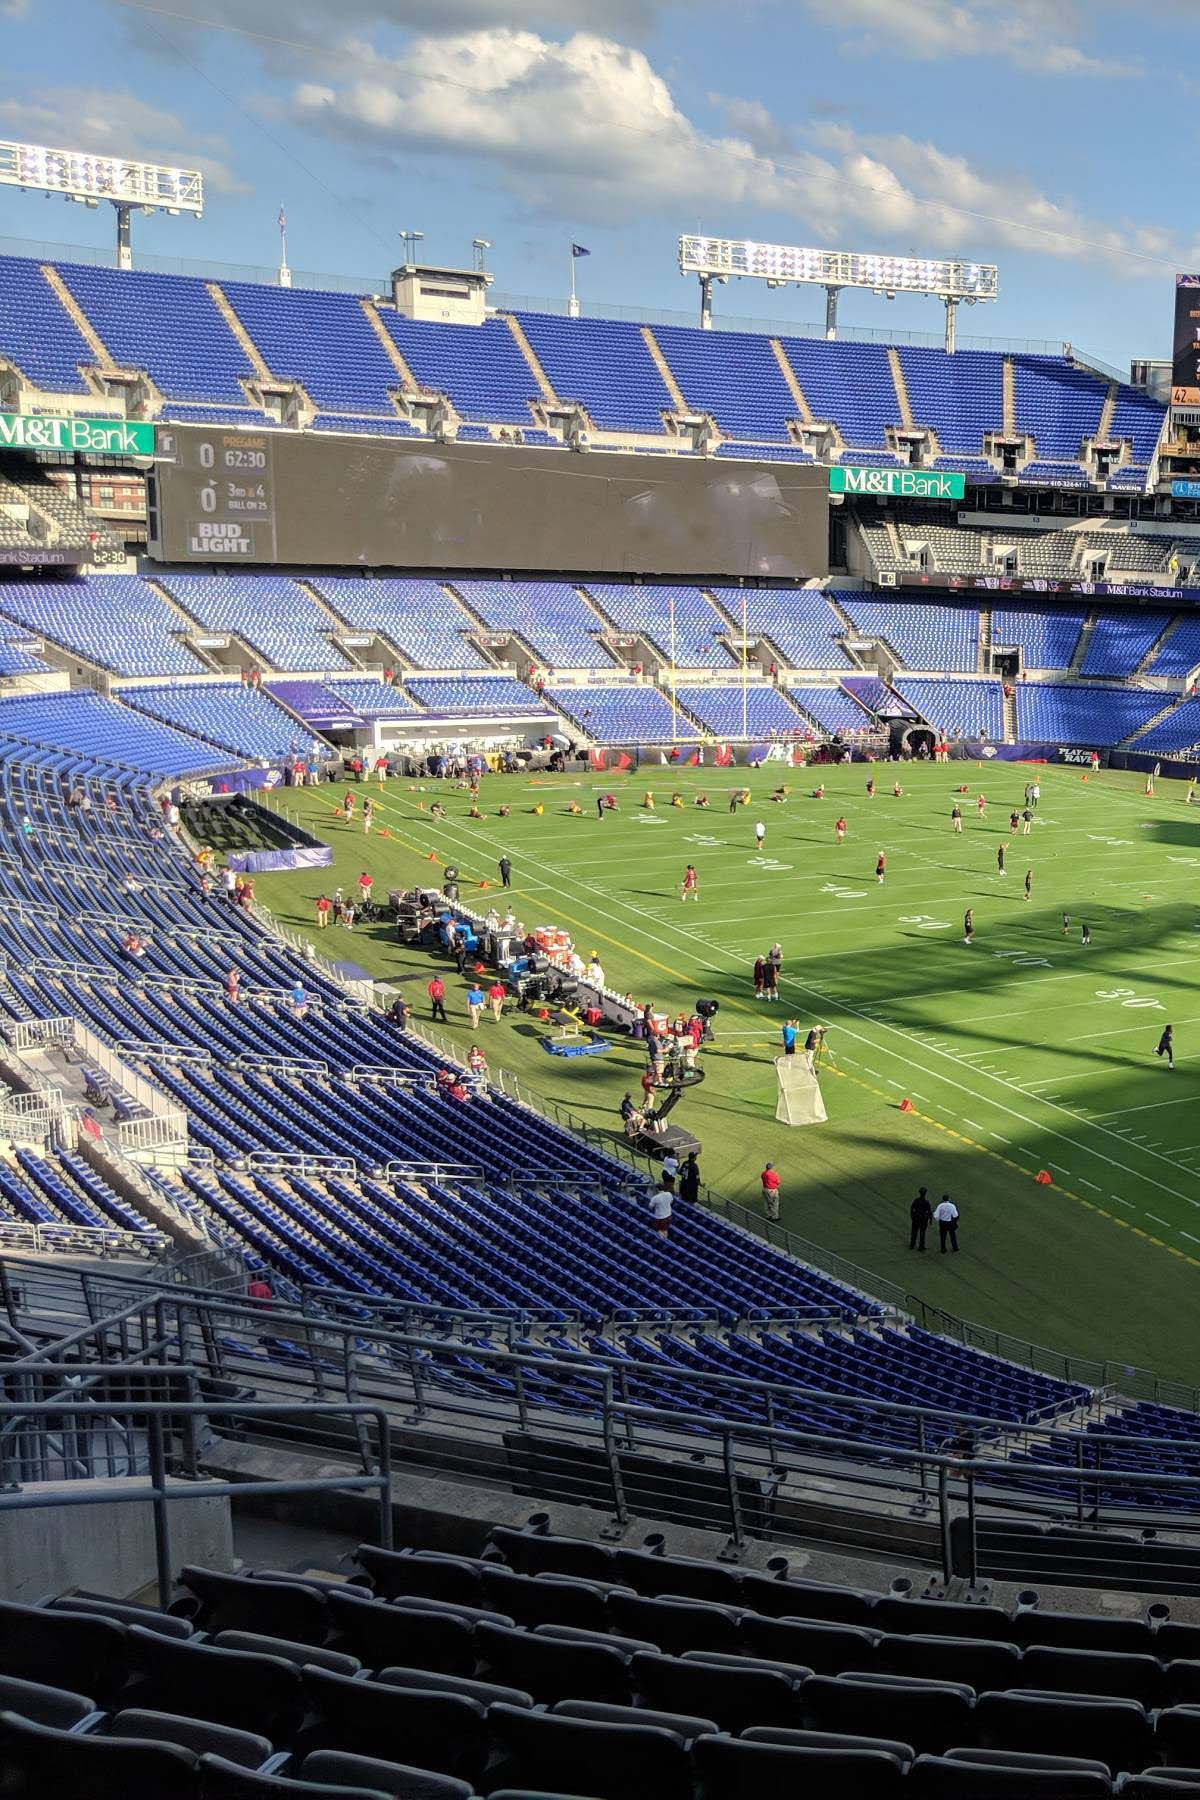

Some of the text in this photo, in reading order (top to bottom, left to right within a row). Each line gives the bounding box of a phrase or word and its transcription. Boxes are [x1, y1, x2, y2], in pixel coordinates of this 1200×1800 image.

[1174, 389, 1186, 403] 42
[0, 416, 139, 450] M&T Bank
[200, 443, 214, 468] 0
[225, 451, 267, 468] 62:30
[256, 484, 264, 497] 4
[843, 469, 952, 497] M&T Bank
[201, 488, 216, 512] 0
[199, 523, 242, 538] BUD
[191, 537, 250, 553] LIGHT
[19, 551, 64, 564] Stadium
[93, 551, 126, 563] 62:30
[1107, 585, 1183, 598] M&T Bank Stadium
[898, 914, 952, 929] 50
[1095, 988, 1159, 1009] 30
